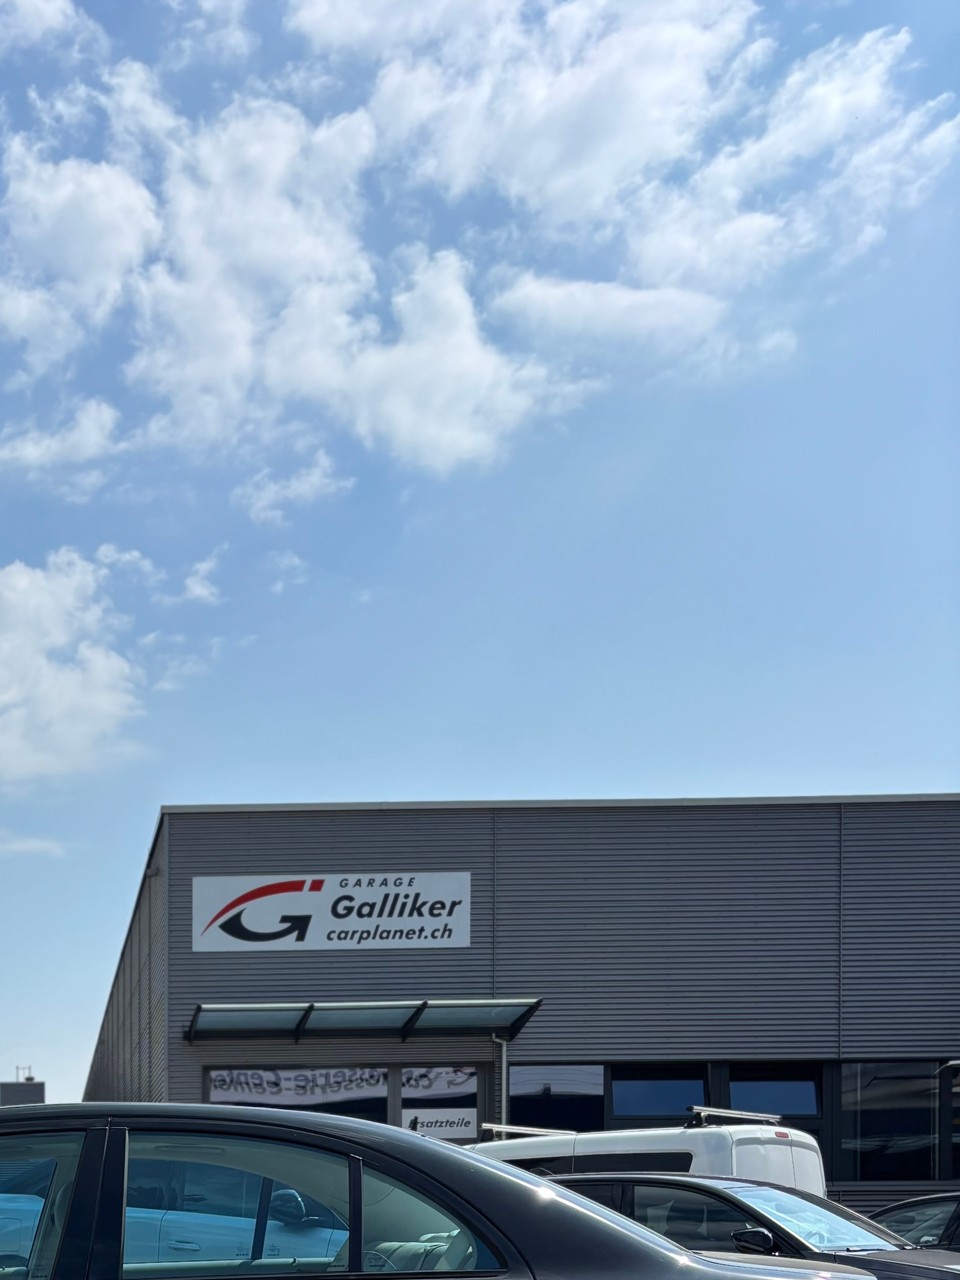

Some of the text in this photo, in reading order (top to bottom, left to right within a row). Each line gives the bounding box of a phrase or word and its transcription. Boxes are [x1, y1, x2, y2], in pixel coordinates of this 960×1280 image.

[339, 877, 416, 889] GARAGE
[330, 893, 462, 919] Galliker
[326, 924, 453, 944] carplanet.ch
